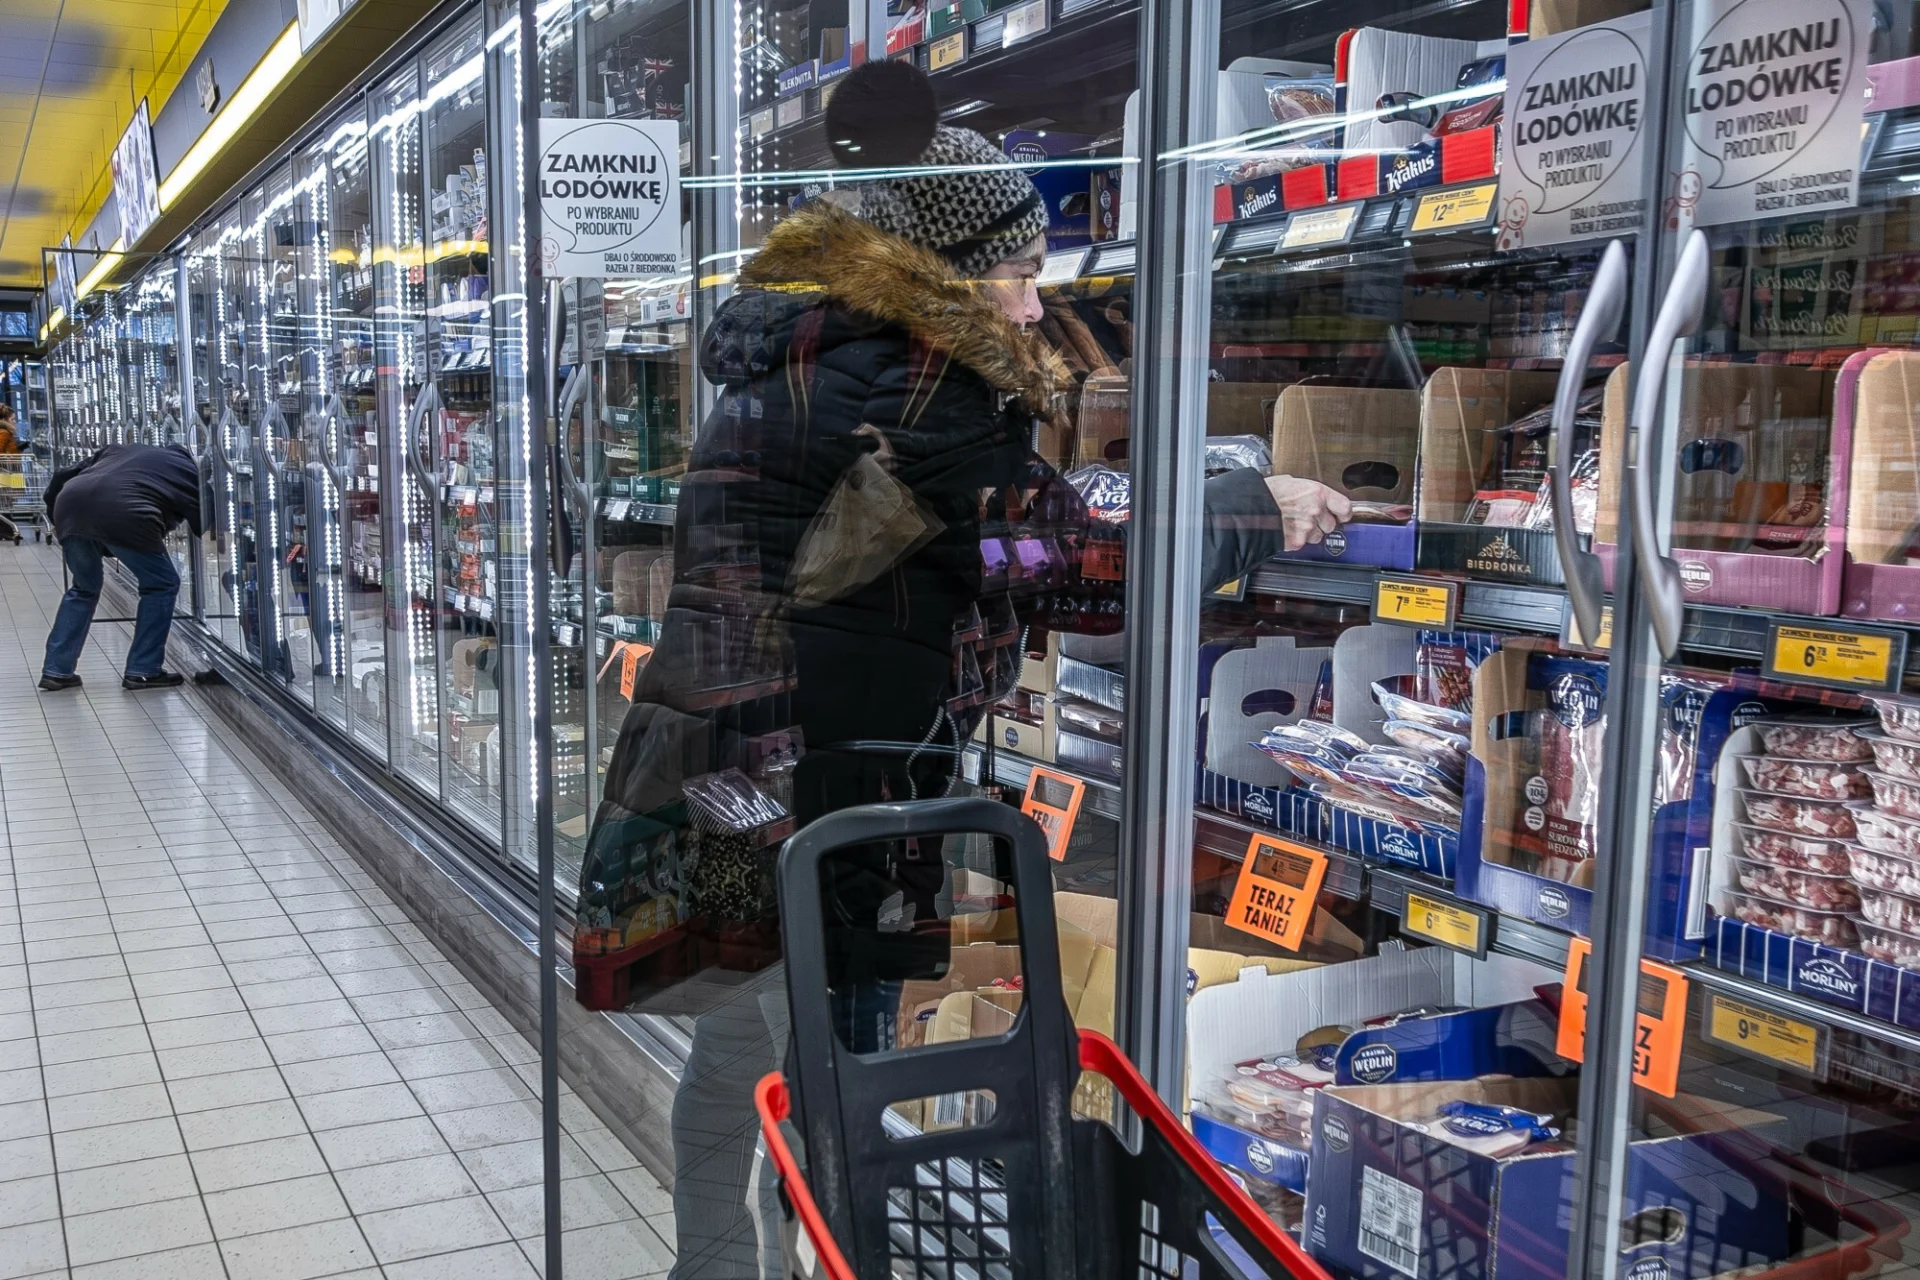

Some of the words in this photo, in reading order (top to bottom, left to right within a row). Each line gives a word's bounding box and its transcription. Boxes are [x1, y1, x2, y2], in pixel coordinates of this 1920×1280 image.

[1697, 18, 1840, 76] ZAMKNIJ
[1524, 63, 1636, 112] ZAMKNIJ
[1688, 57, 1842, 114] LODÓWKĘ
[1516, 99, 1638, 147] LODÓWKĘ
[1715, 119, 1733, 140] PO
[1737, 104, 1808, 136] WYBRANIU
[1538, 151, 1553, 170] PO
[1555, 140, 1612, 168] WYBRANIU
[1722, 130, 1796, 161] PRODUKTU
[546, 154, 657, 174] ZAMKNIJ
[1385, 153, 1435, 192] Krakus
[1545, 163, 1602, 190] PRODUKTU
[541, 175, 661, 204] LODÓWKĘ
[567, 206, 582, 219] PO
[585, 206, 639, 220] WYBRANIU
[1238, 189, 1277, 219] Krakus
[1432, 204, 1448, 222] 12
[575, 222, 632, 236] PRODUKTU
[604, 252, 621, 263] DBAJ
[623, 253, 629, 262] O
[630, 250, 676, 263] ŚRODOWISKO
[605, 264, 629, 274] RAZEM
[630, 264, 635, 273] Z
[636, 264, 676, 275] BIEDRONKĄ
[1467, 559, 1532, 575] BIEDRONKA
[1396, 595, 1403, 613] 7
[1804, 645, 1816, 667] 6
[1244, 799, 1274, 815] MORLINY
[1381, 841, 1419, 861] MORLINY
[1249, 884, 1296, 916] TERAZ
[1244, 905, 1289, 937] TANIEJ
[1426, 912, 1433, 929] 6
[1799, 968, 1857, 994] MORLINY
[1738, 1018, 1749, 1040] 9
[1354, 1055, 1393, 1073] WĘDLIN
[1361, 1049, 1386, 1058] KRAINA
